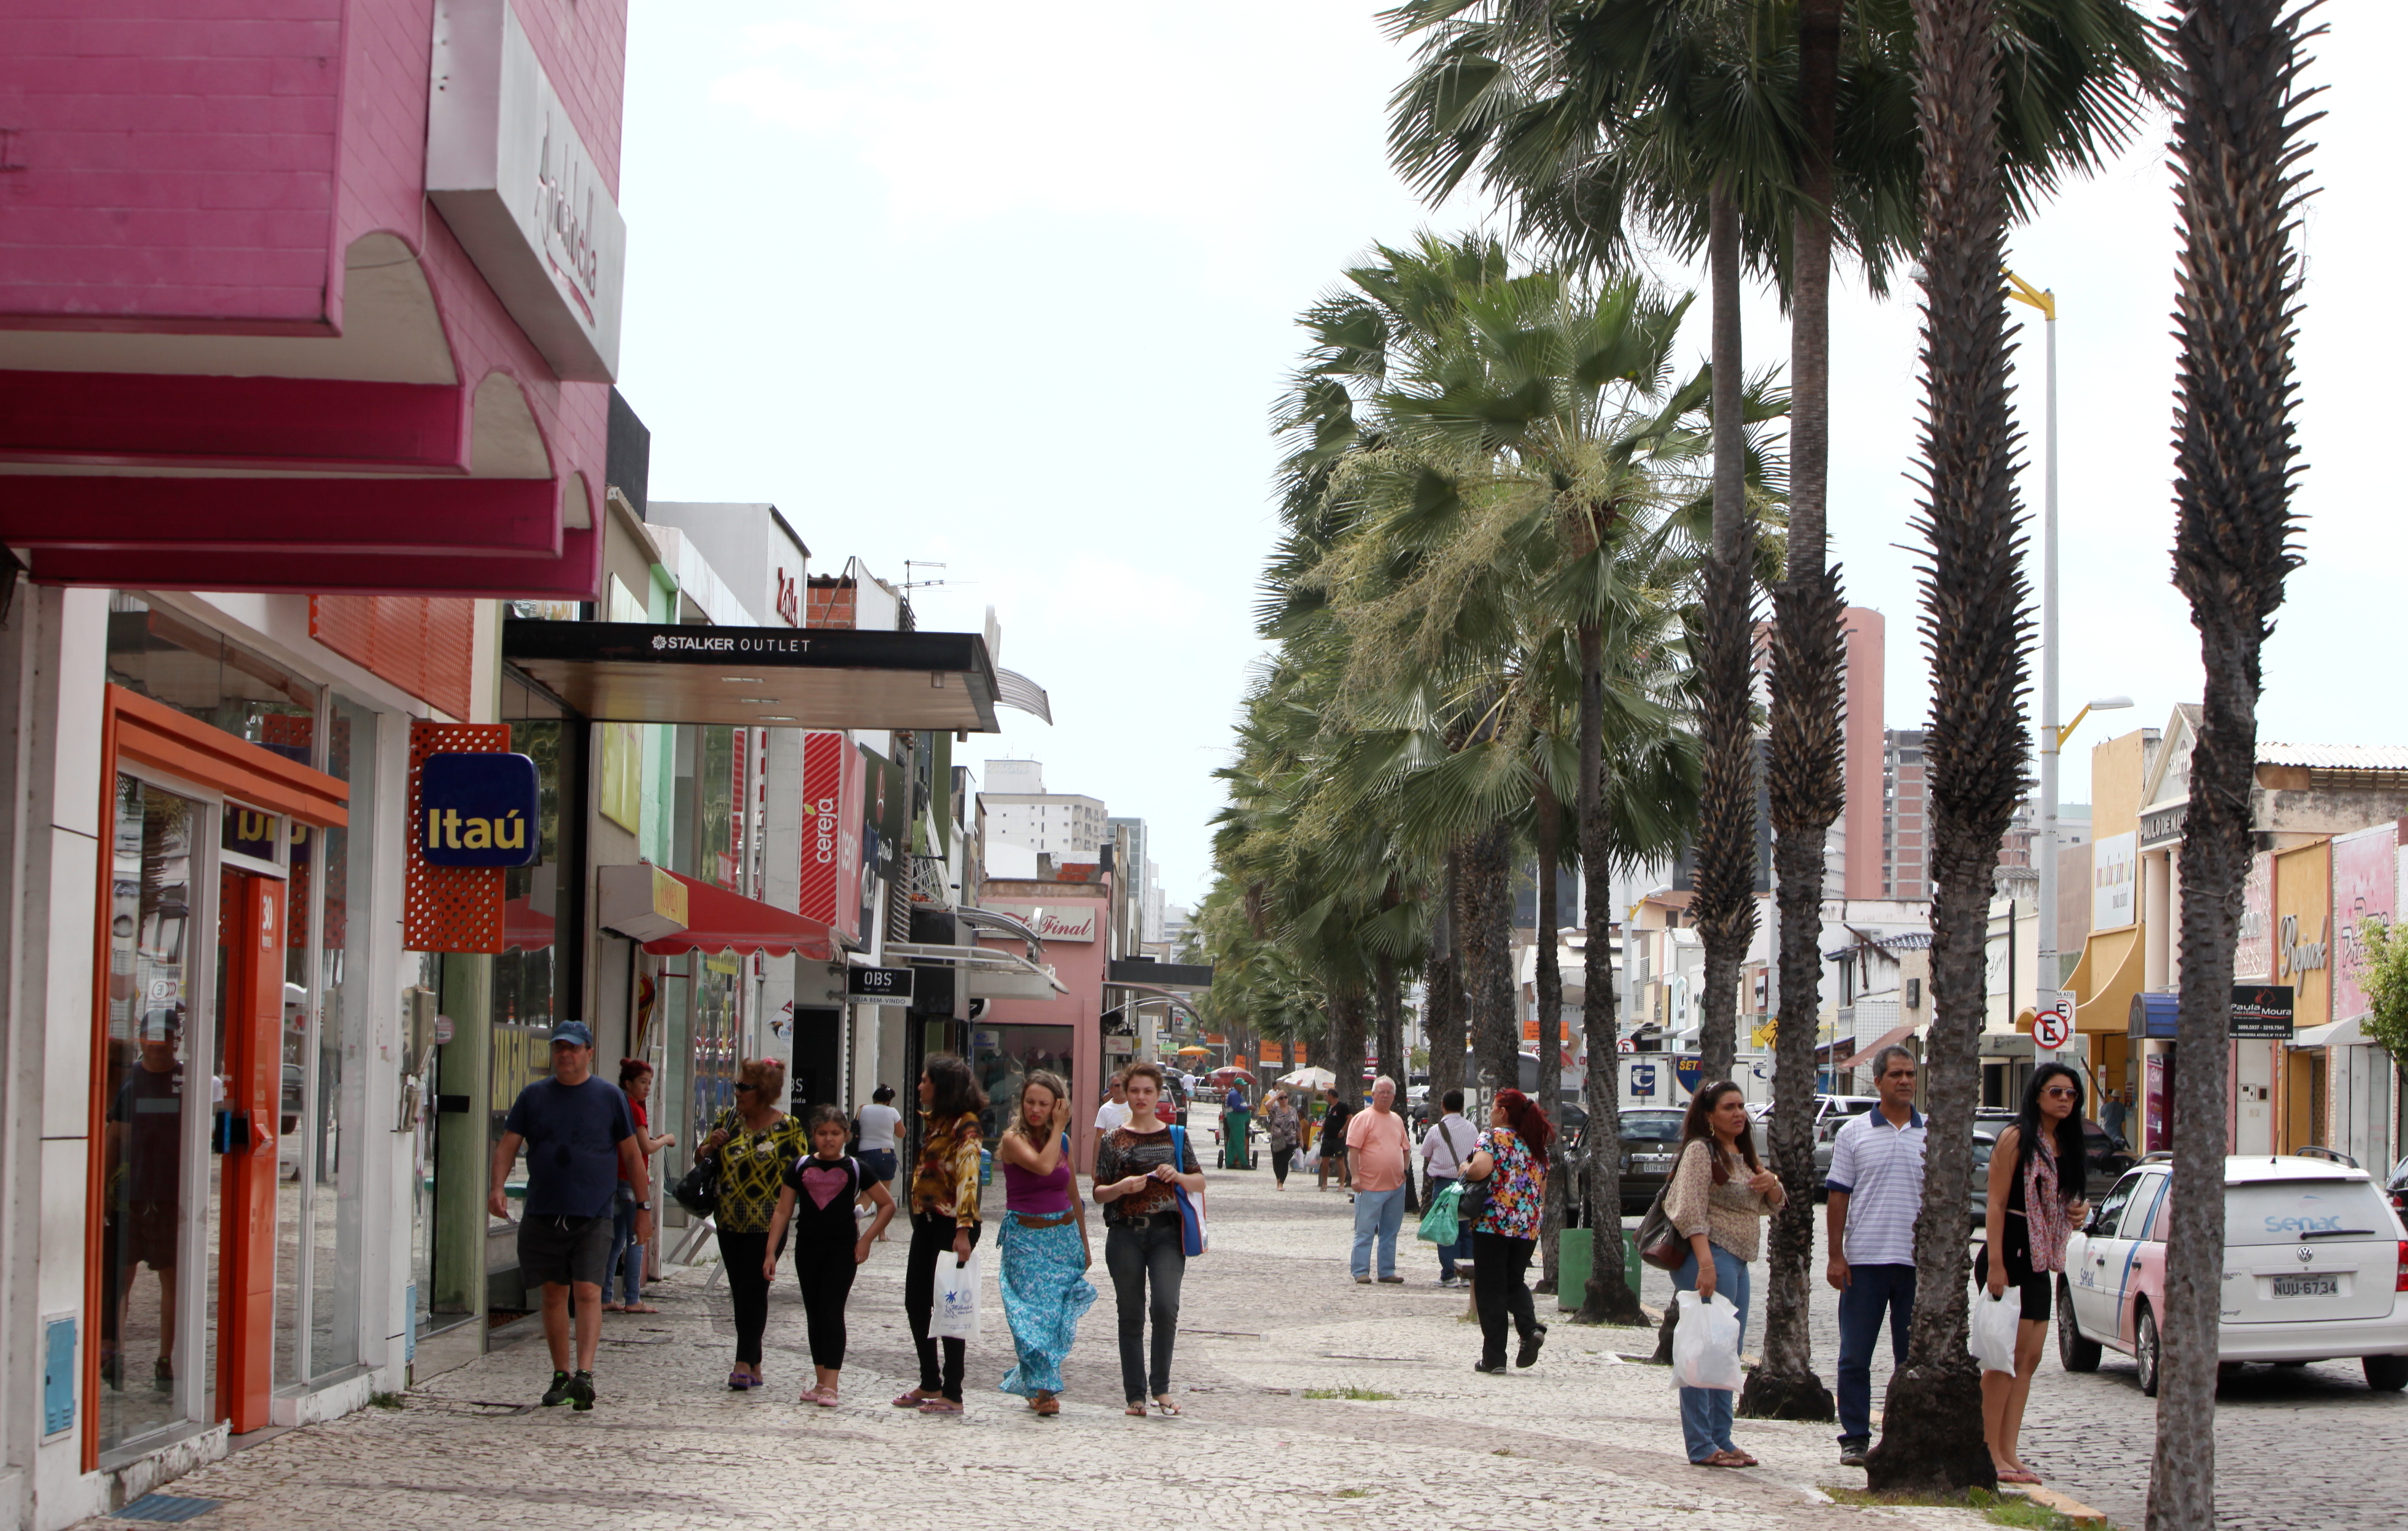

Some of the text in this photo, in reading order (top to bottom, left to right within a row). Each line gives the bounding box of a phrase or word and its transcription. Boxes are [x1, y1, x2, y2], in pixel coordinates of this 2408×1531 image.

[668, 637, 810, 652] STALKER OUTLET
[2169, 746, 2193, 776] SHOPPIN
[428, 808, 525, 850] Itaú
[816, 797, 837, 863] cereja
[2140, 817, 2161, 841] PAULO
[2161, 814, 2170, 837] DE
[262, 895, 273, 930] 30
[1040, 915, 1092, 935] Final
